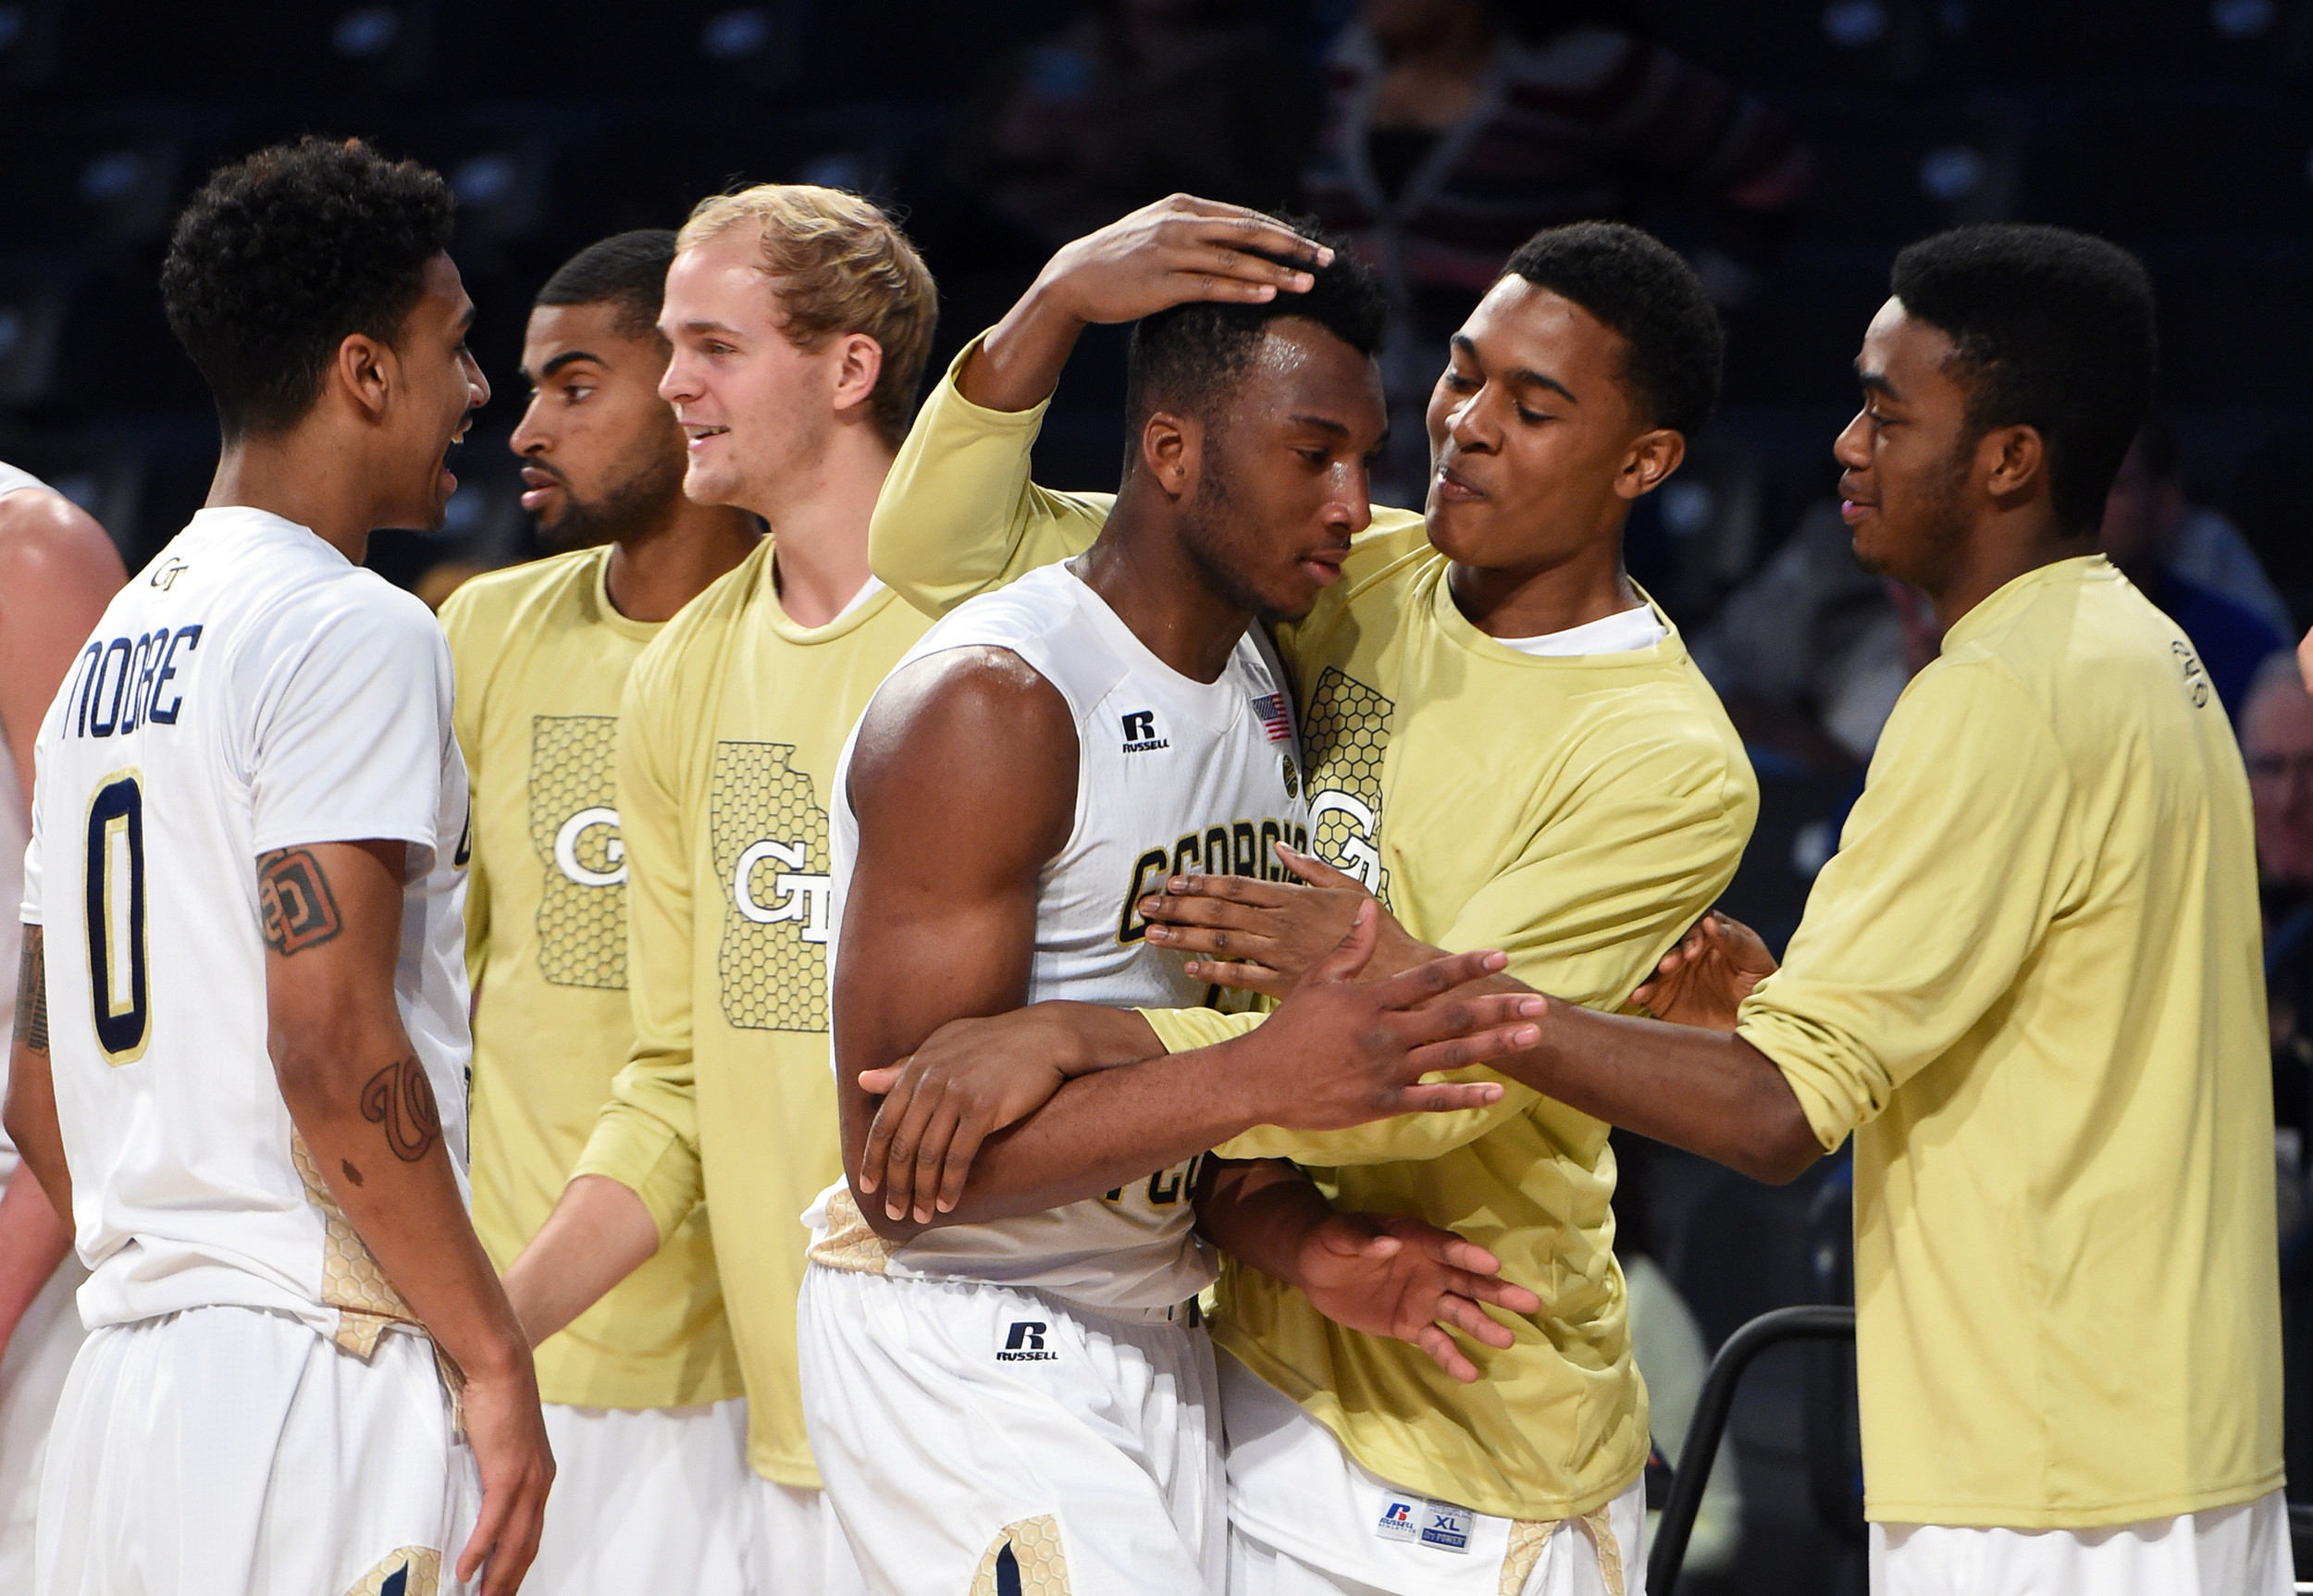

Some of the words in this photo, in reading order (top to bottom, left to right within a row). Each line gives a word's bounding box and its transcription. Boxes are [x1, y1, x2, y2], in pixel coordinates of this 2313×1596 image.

[1122, 738, 1169, 753] RUSSELL
[555, 806, 628, 887] G
[82, 765, 152, 1068] 0
[996, 1351, 1058, 1361] RUSSELL
[1379, 1517, 1414, 1529] RUSSELL
[1433, 1515, 1460, 1531] XL
